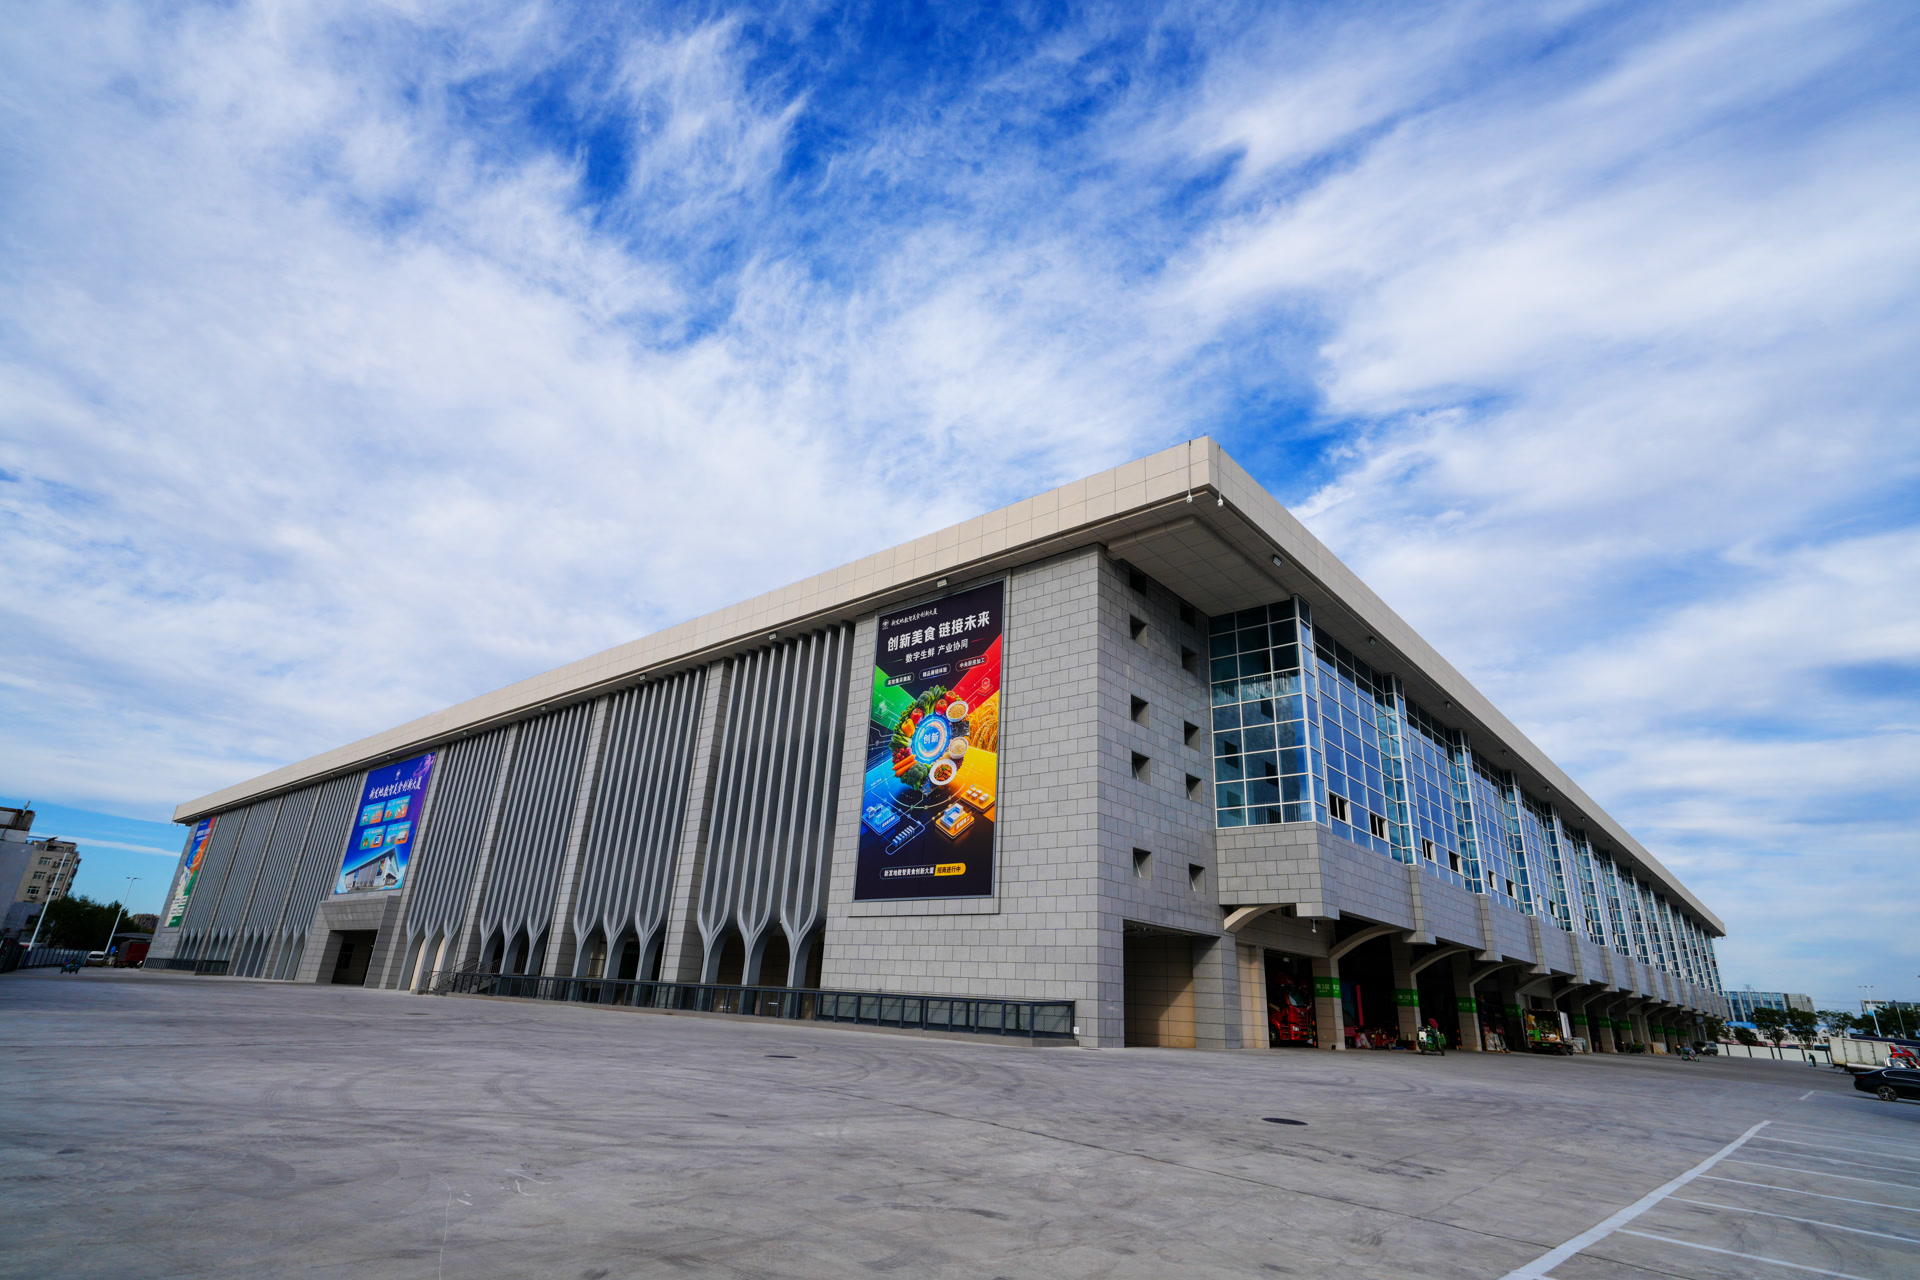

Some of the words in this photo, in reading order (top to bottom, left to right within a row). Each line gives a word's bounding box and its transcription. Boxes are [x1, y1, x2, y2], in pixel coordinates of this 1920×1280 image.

[887, 626, 936, 652] 创新美食
[938, 611, 990, 638] 链接未来
[905, 647, 935, 663] 数字生鲜
[938, 638, 968, 655] 产业协同
[923, 732, 939, 745] 创新
